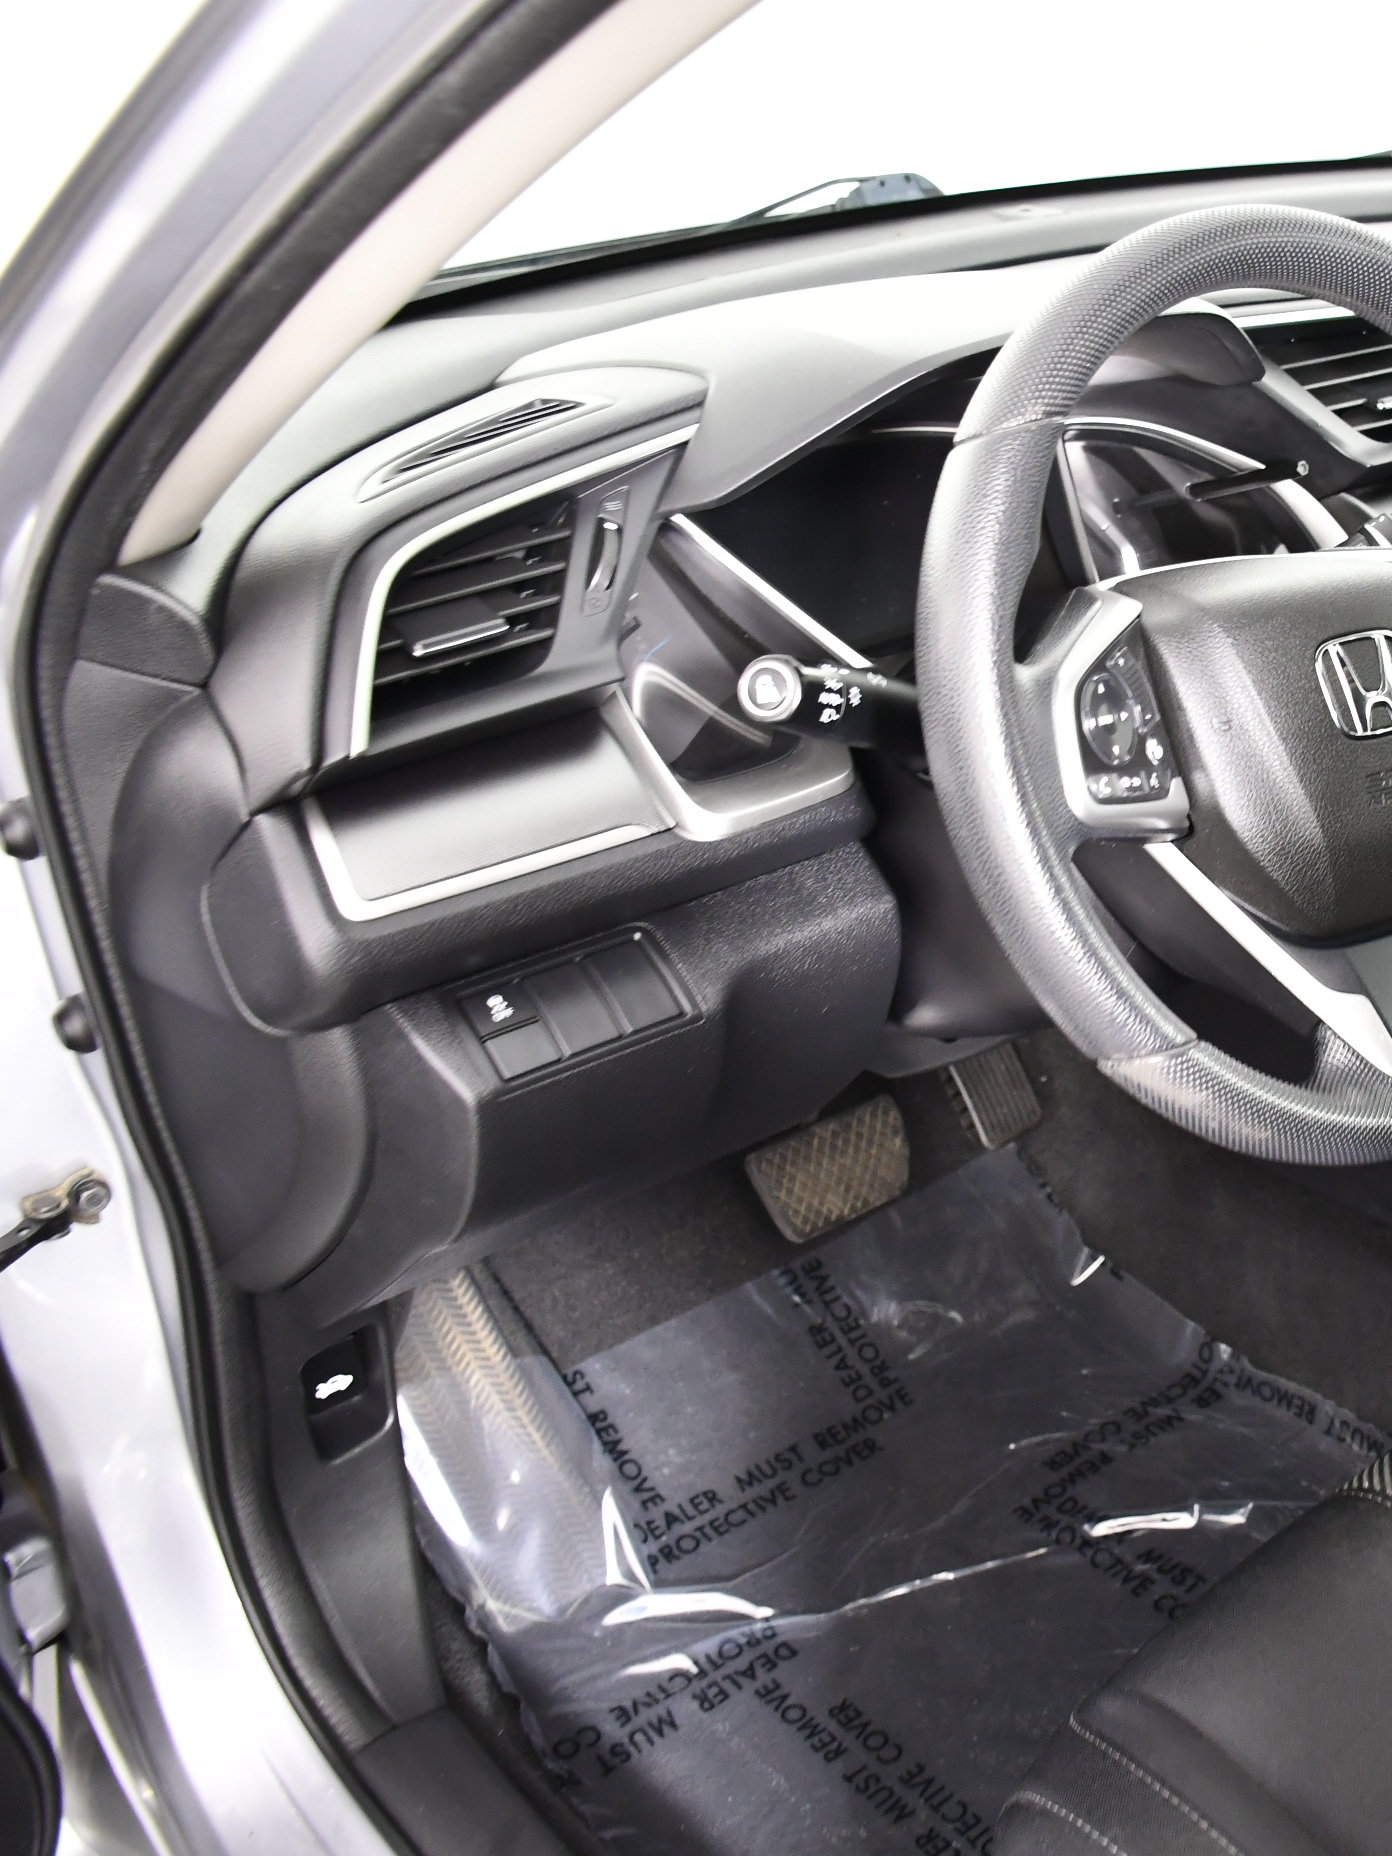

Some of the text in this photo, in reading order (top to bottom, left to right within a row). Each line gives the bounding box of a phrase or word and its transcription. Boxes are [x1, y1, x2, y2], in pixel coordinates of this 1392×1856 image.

[801, 1257, 899, 1390] PROTECTIVE
[808, 1319, 876, 1404] DEALER
[587, 1407, 667, 1512] REMOVE
[733, 1443, 807, 1494] MUST
[812, 1384, 914, 1452] REMOVE
[1042, 1420, 1122, 1472] COVER
[647, 1437, 884, 1575] PROTECTIVE COVER
[1136, 1547, 1207, 1593] MUST
[596, 1640, 799, 1777] DEALER MUST
[754, 1677, 847, 1764] REMOVE
[828, 1697, 904, 1766] COVER
[842, 1764, 917, 1824] MUST
